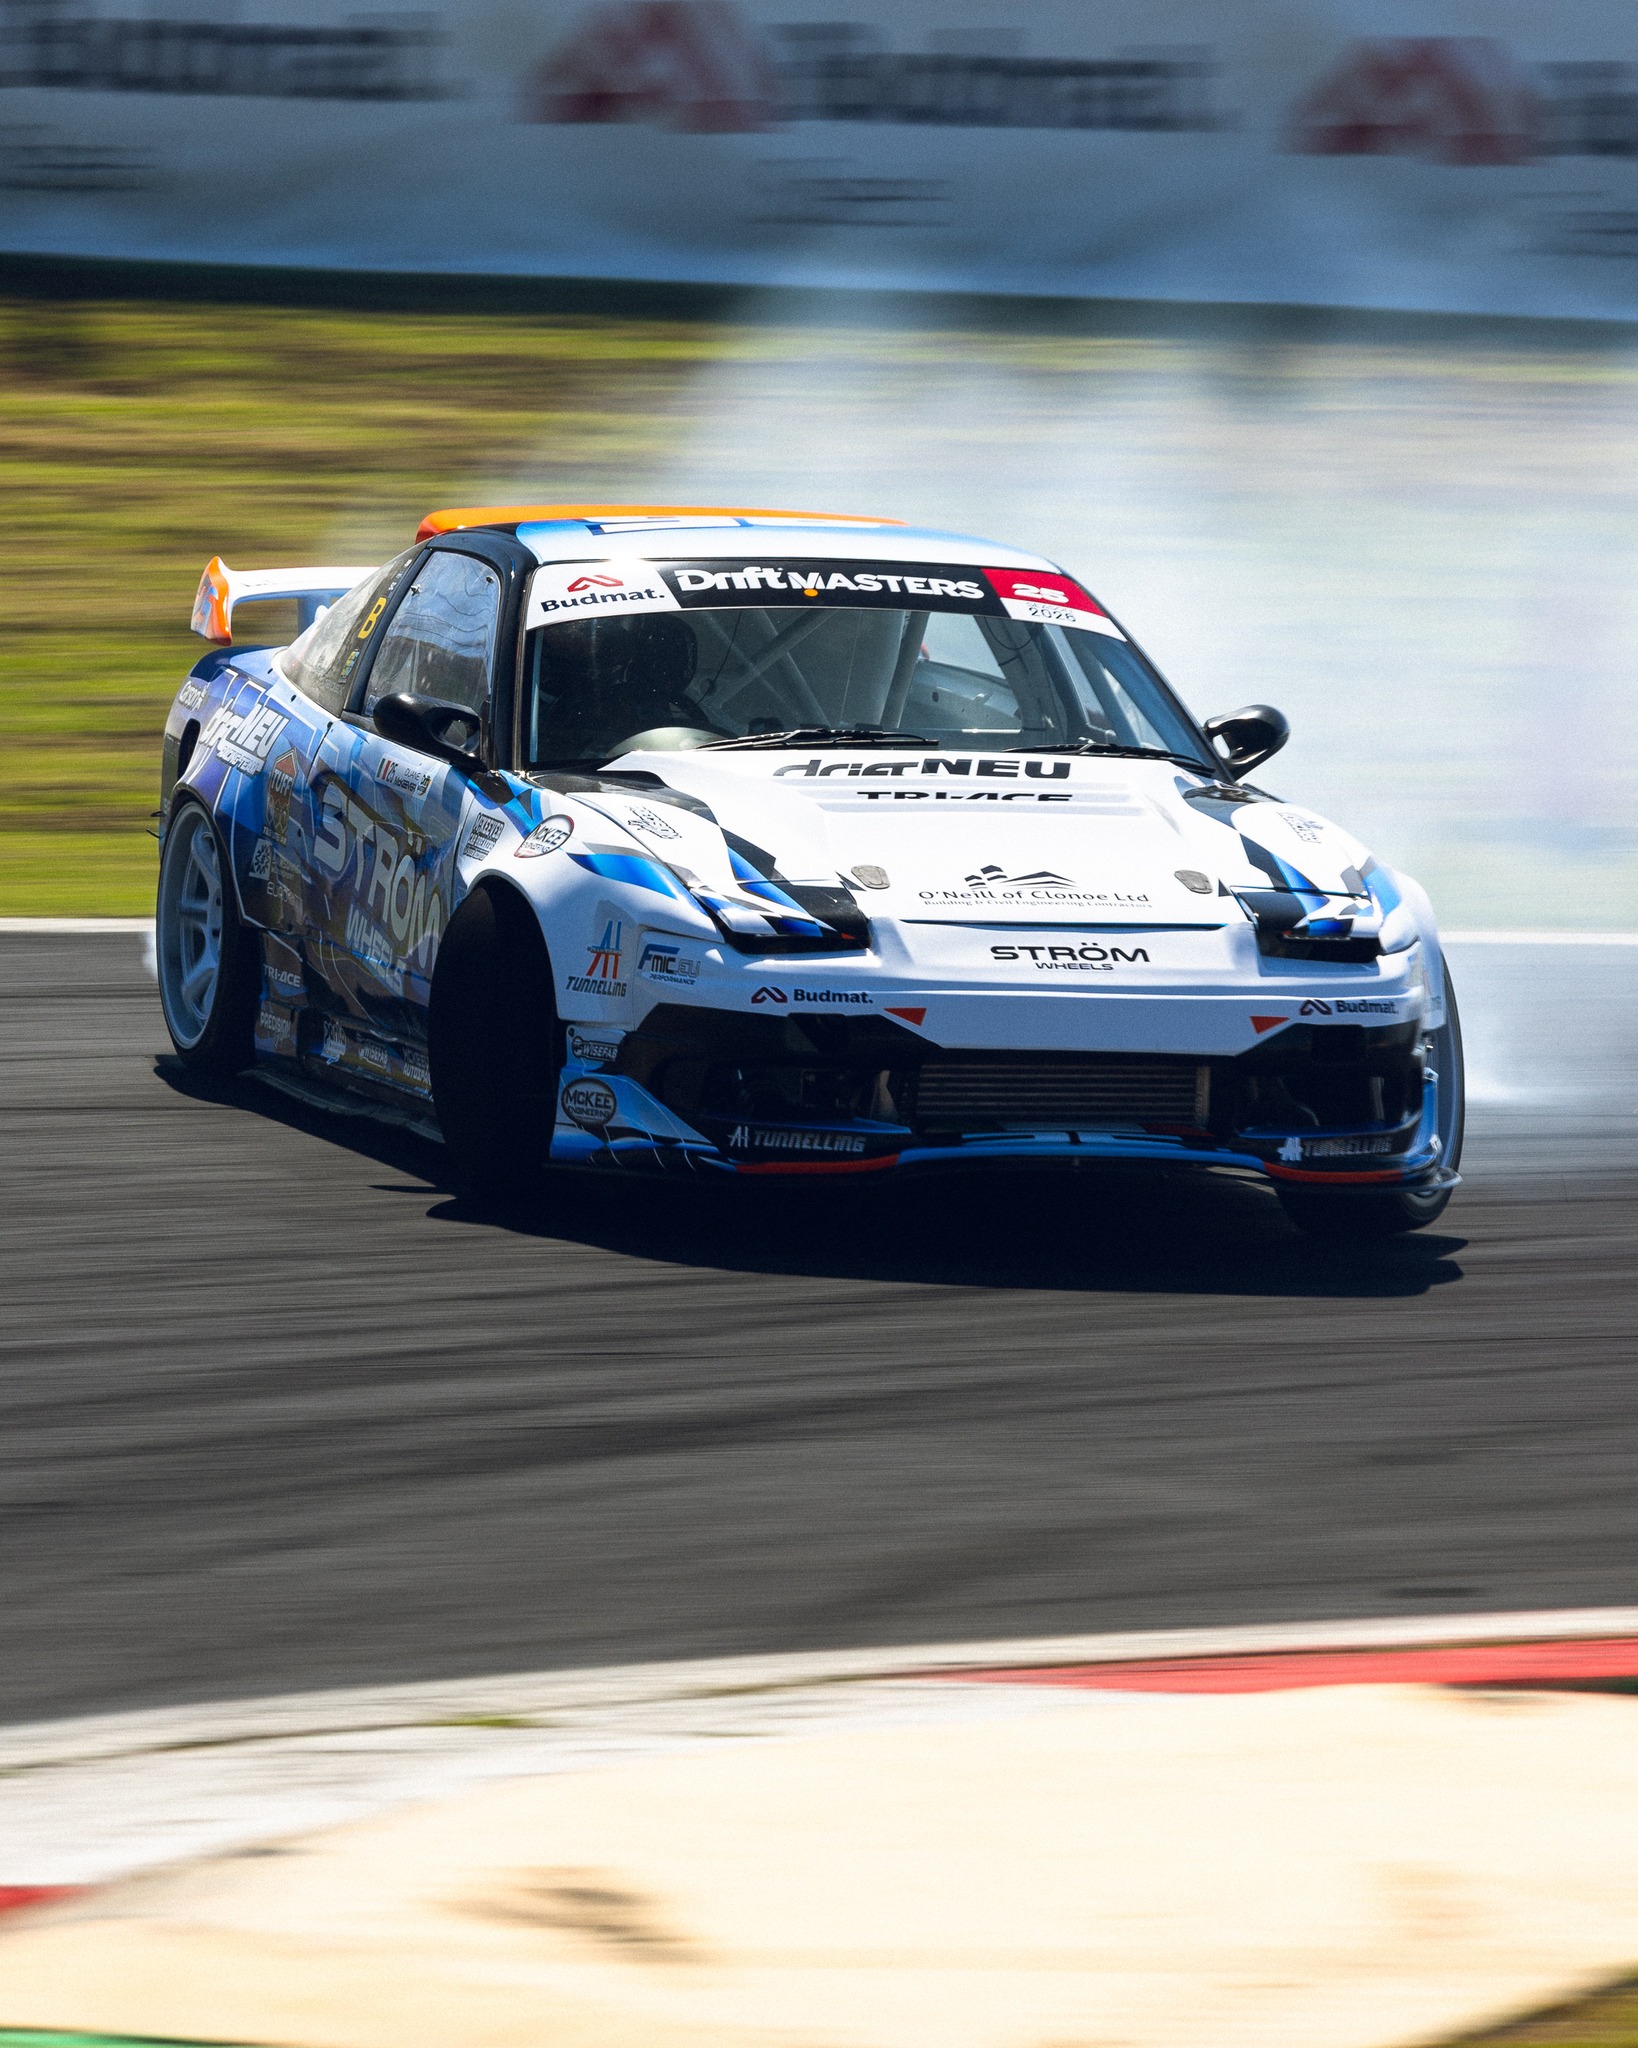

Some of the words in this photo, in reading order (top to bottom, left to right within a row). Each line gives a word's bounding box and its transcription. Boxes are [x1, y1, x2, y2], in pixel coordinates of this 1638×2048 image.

[788, 571, 985, 599] MASTERS
[1012, 583, 1069, 604] 25
[540, 588, 665, 613] Budmat.
[1029, 606, 1076, 623] 2026
[271, 768, 294, 796] TUFF
[1003, 890, 1024, 899] of
[1031, 891, 1108, 901] Clonoe
[1113, 893, 1150, 902] Ltd
[990, 942, 1150, 963] STRÖM
[263, 963, 301, 988] TRI-ACE
[1035, 962, 1114, 971] WHEELS
[649, 972, 696, 986] PERFORMANCE
[793, 988, 873, 1005] Budmat.
